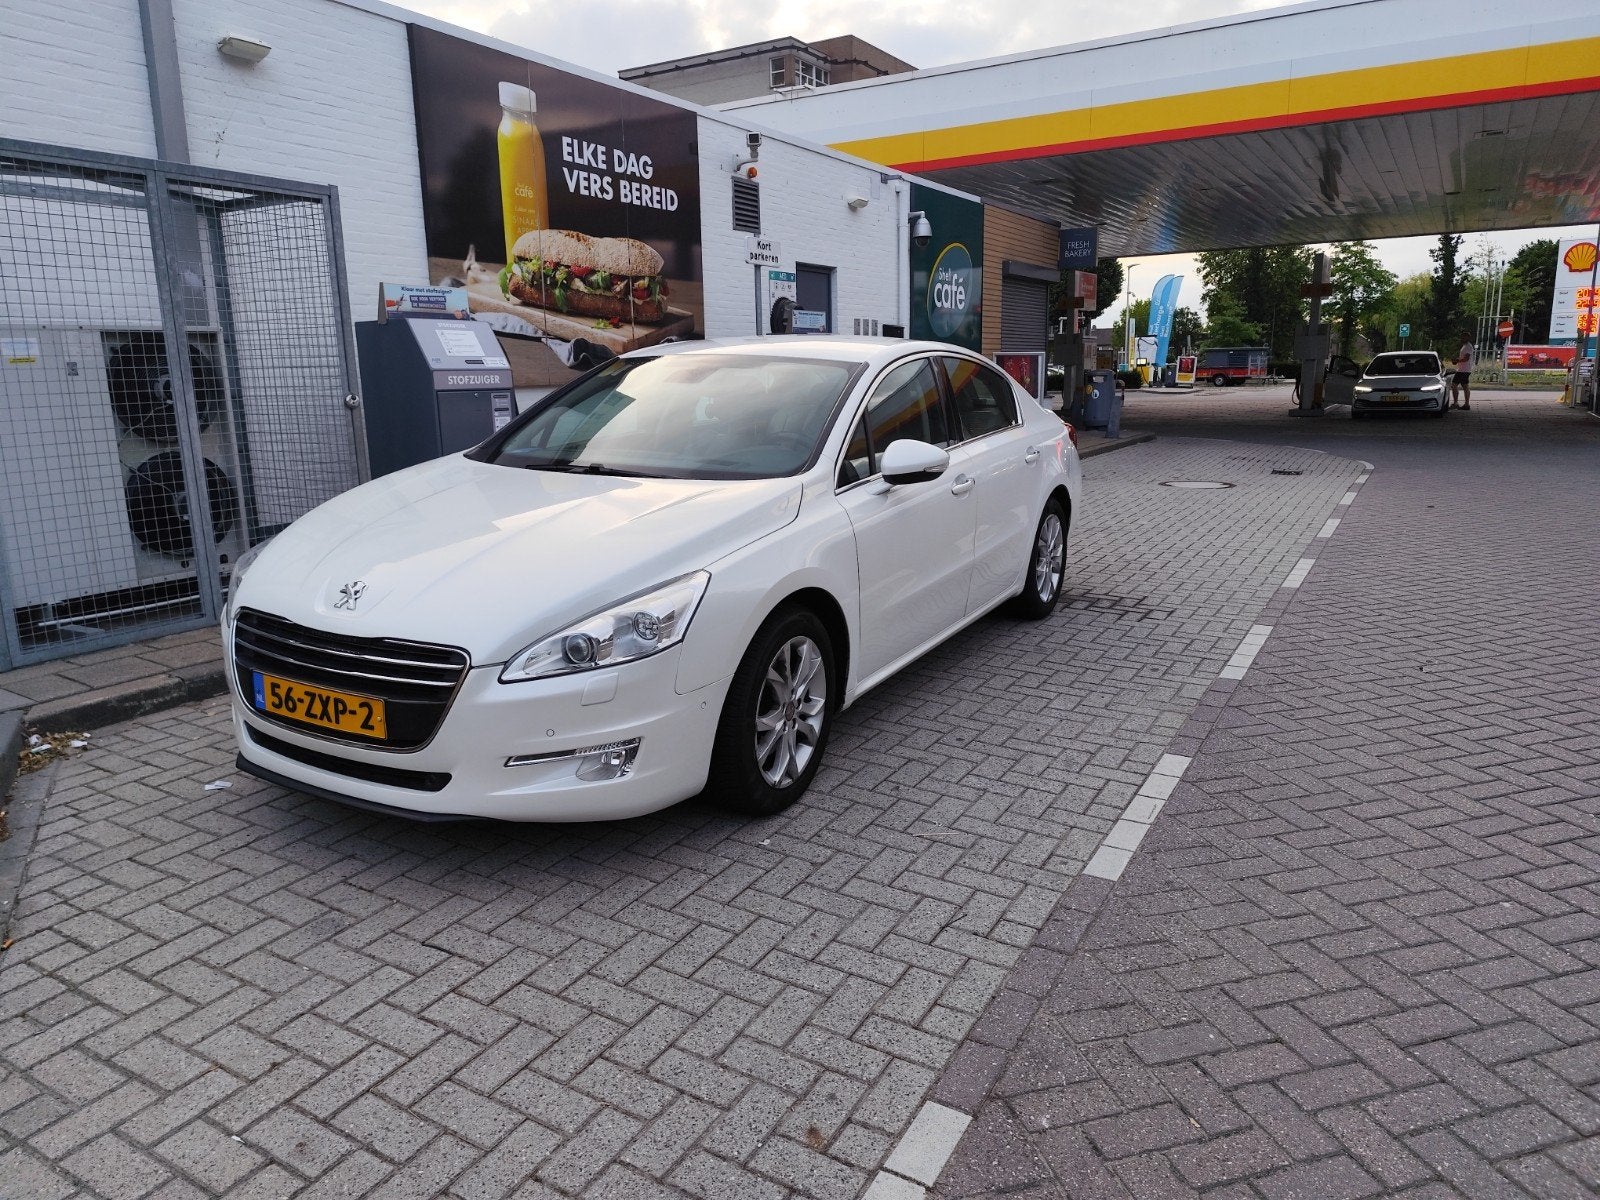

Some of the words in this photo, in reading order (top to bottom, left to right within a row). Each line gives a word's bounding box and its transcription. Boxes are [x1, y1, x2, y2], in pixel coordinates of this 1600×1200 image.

[562, 136, 607, 170] ELKE
[613, 149, 653, 179] DAG
[562, 167, 613, 201] VERS
[619, 180, 678, 212] BEREID
[757, 240, 771, 251] Kort
[1068, 240, 1090, 249] FRESH
[750, 252, 778, 263] parkeren
[1065, 248, 1092, 258] BAKERY
[934, 273, 965, 309] café
[448, 375, 500, 385] STOFZUIGER
[271, 682, 375, 731] 56-ZXP-2
